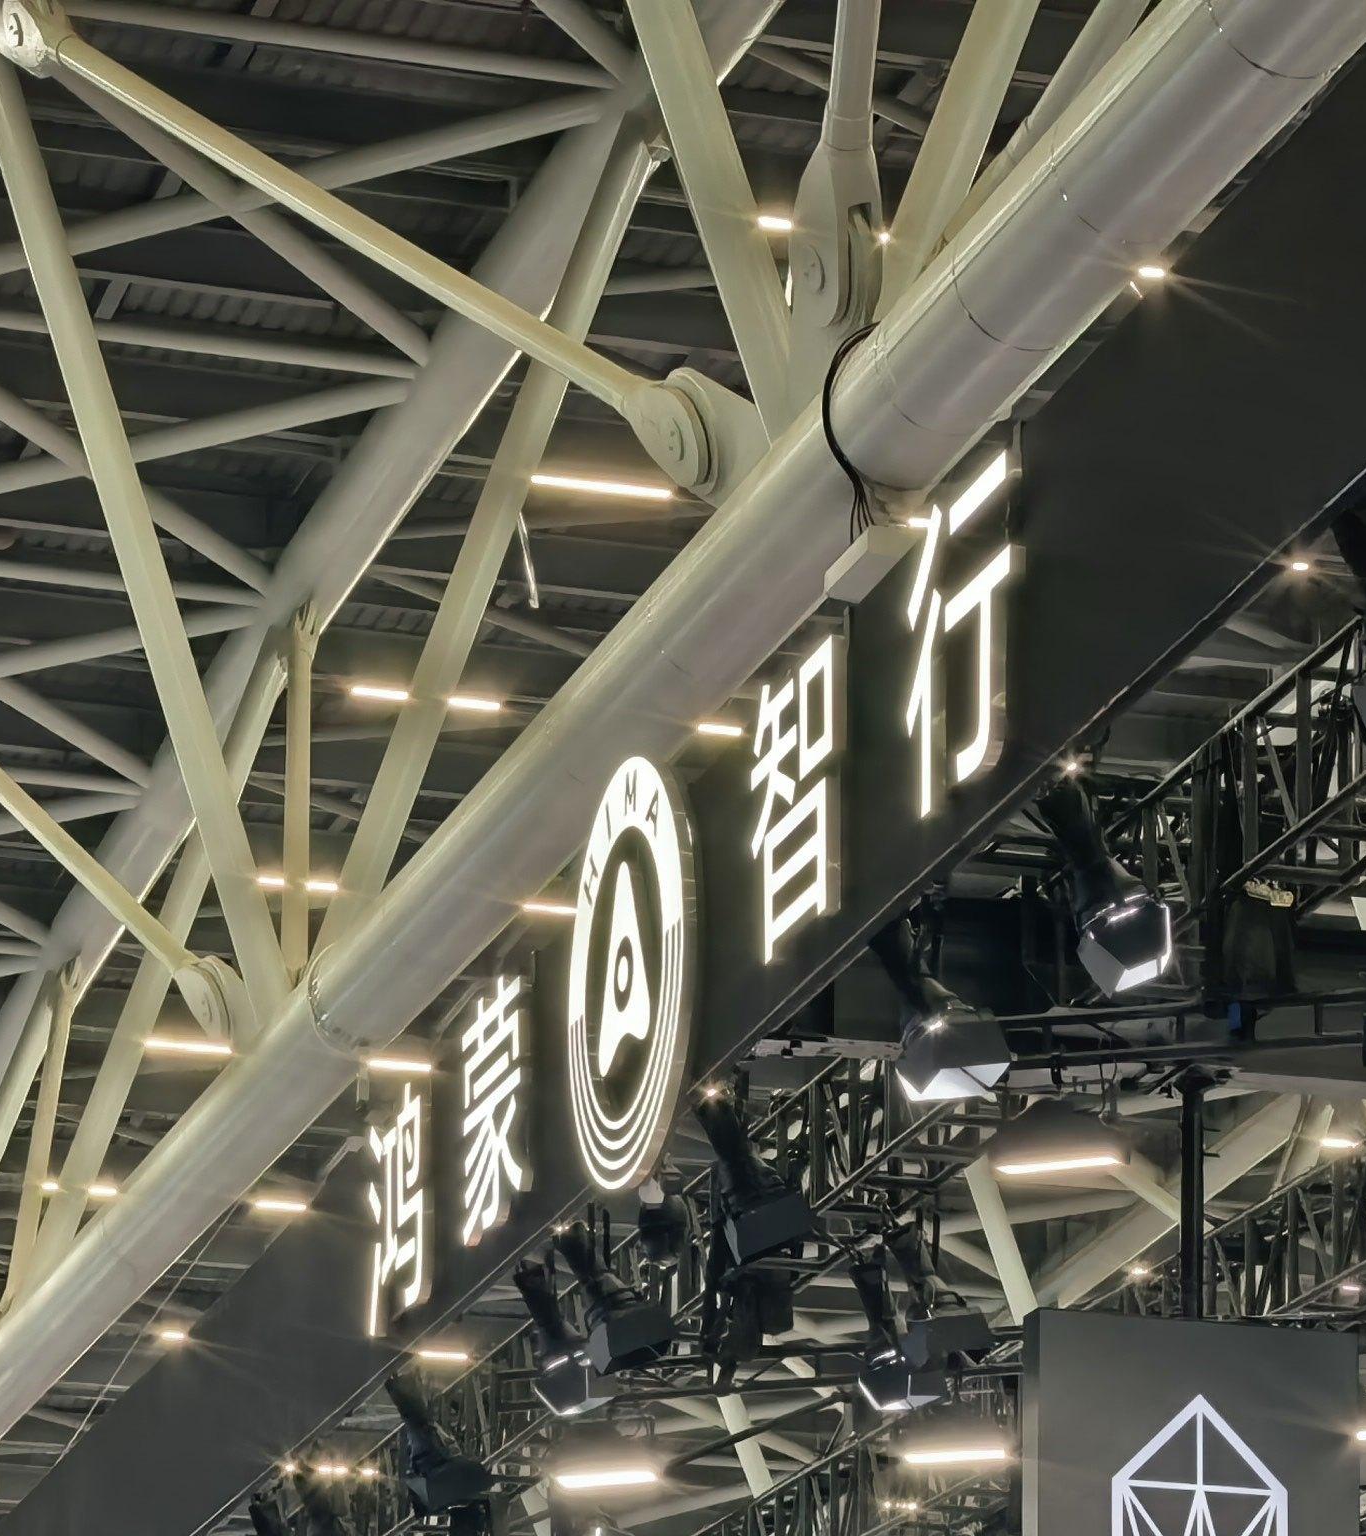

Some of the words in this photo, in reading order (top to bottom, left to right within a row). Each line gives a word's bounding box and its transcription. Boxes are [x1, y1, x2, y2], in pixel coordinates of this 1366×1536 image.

[367, 974, 524, 1338] 鸿蒙
[750, 451, 1011, 964] 智行
[583, 769, 659, 906] HIMA
